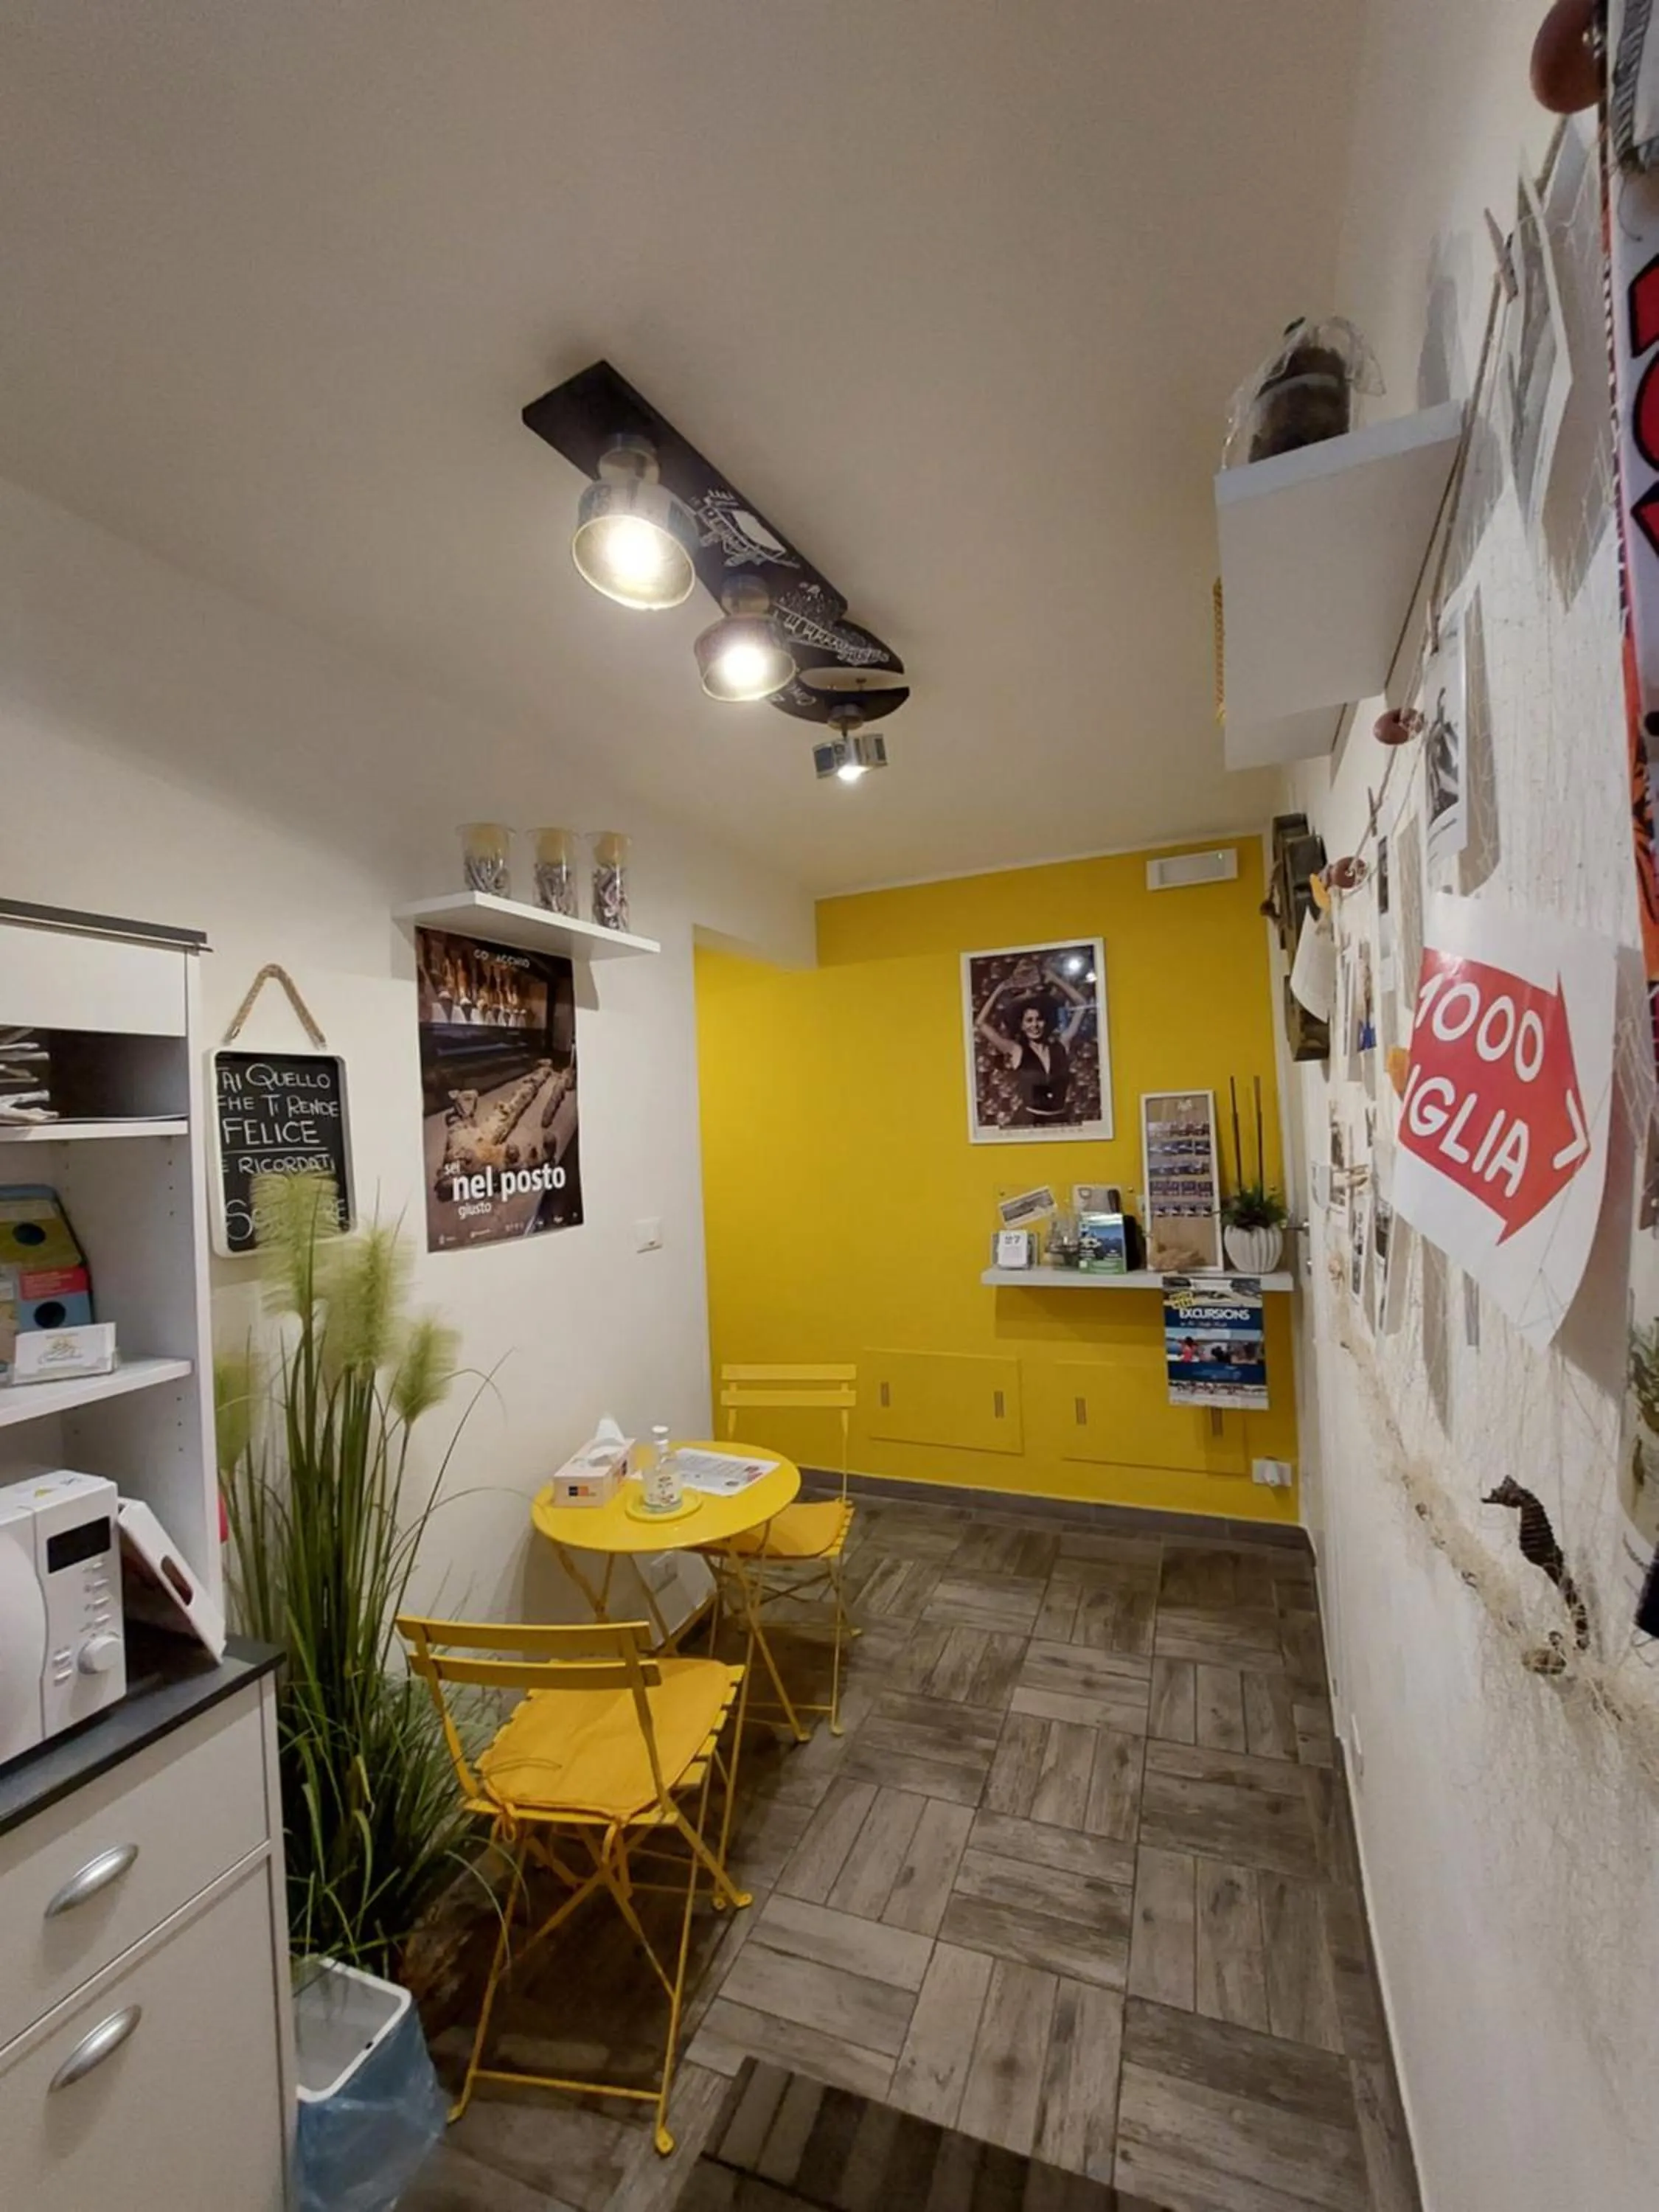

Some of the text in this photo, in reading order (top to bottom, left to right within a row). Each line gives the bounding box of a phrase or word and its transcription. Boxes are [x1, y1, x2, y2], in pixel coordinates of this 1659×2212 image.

[246, 1062, 331, 1091] QUELLO
[286, 1094, 339, 1119] RENDE
[222, 1116, 321, 1145] FELICE
[237, 1153, 336, 1175] RICORDATI
[452, 1162, 566, 1203] nel posto
[458, 1201, 492, 1221] giusto
[1179, 1307, 1251, 1321] EXCURSIONS
